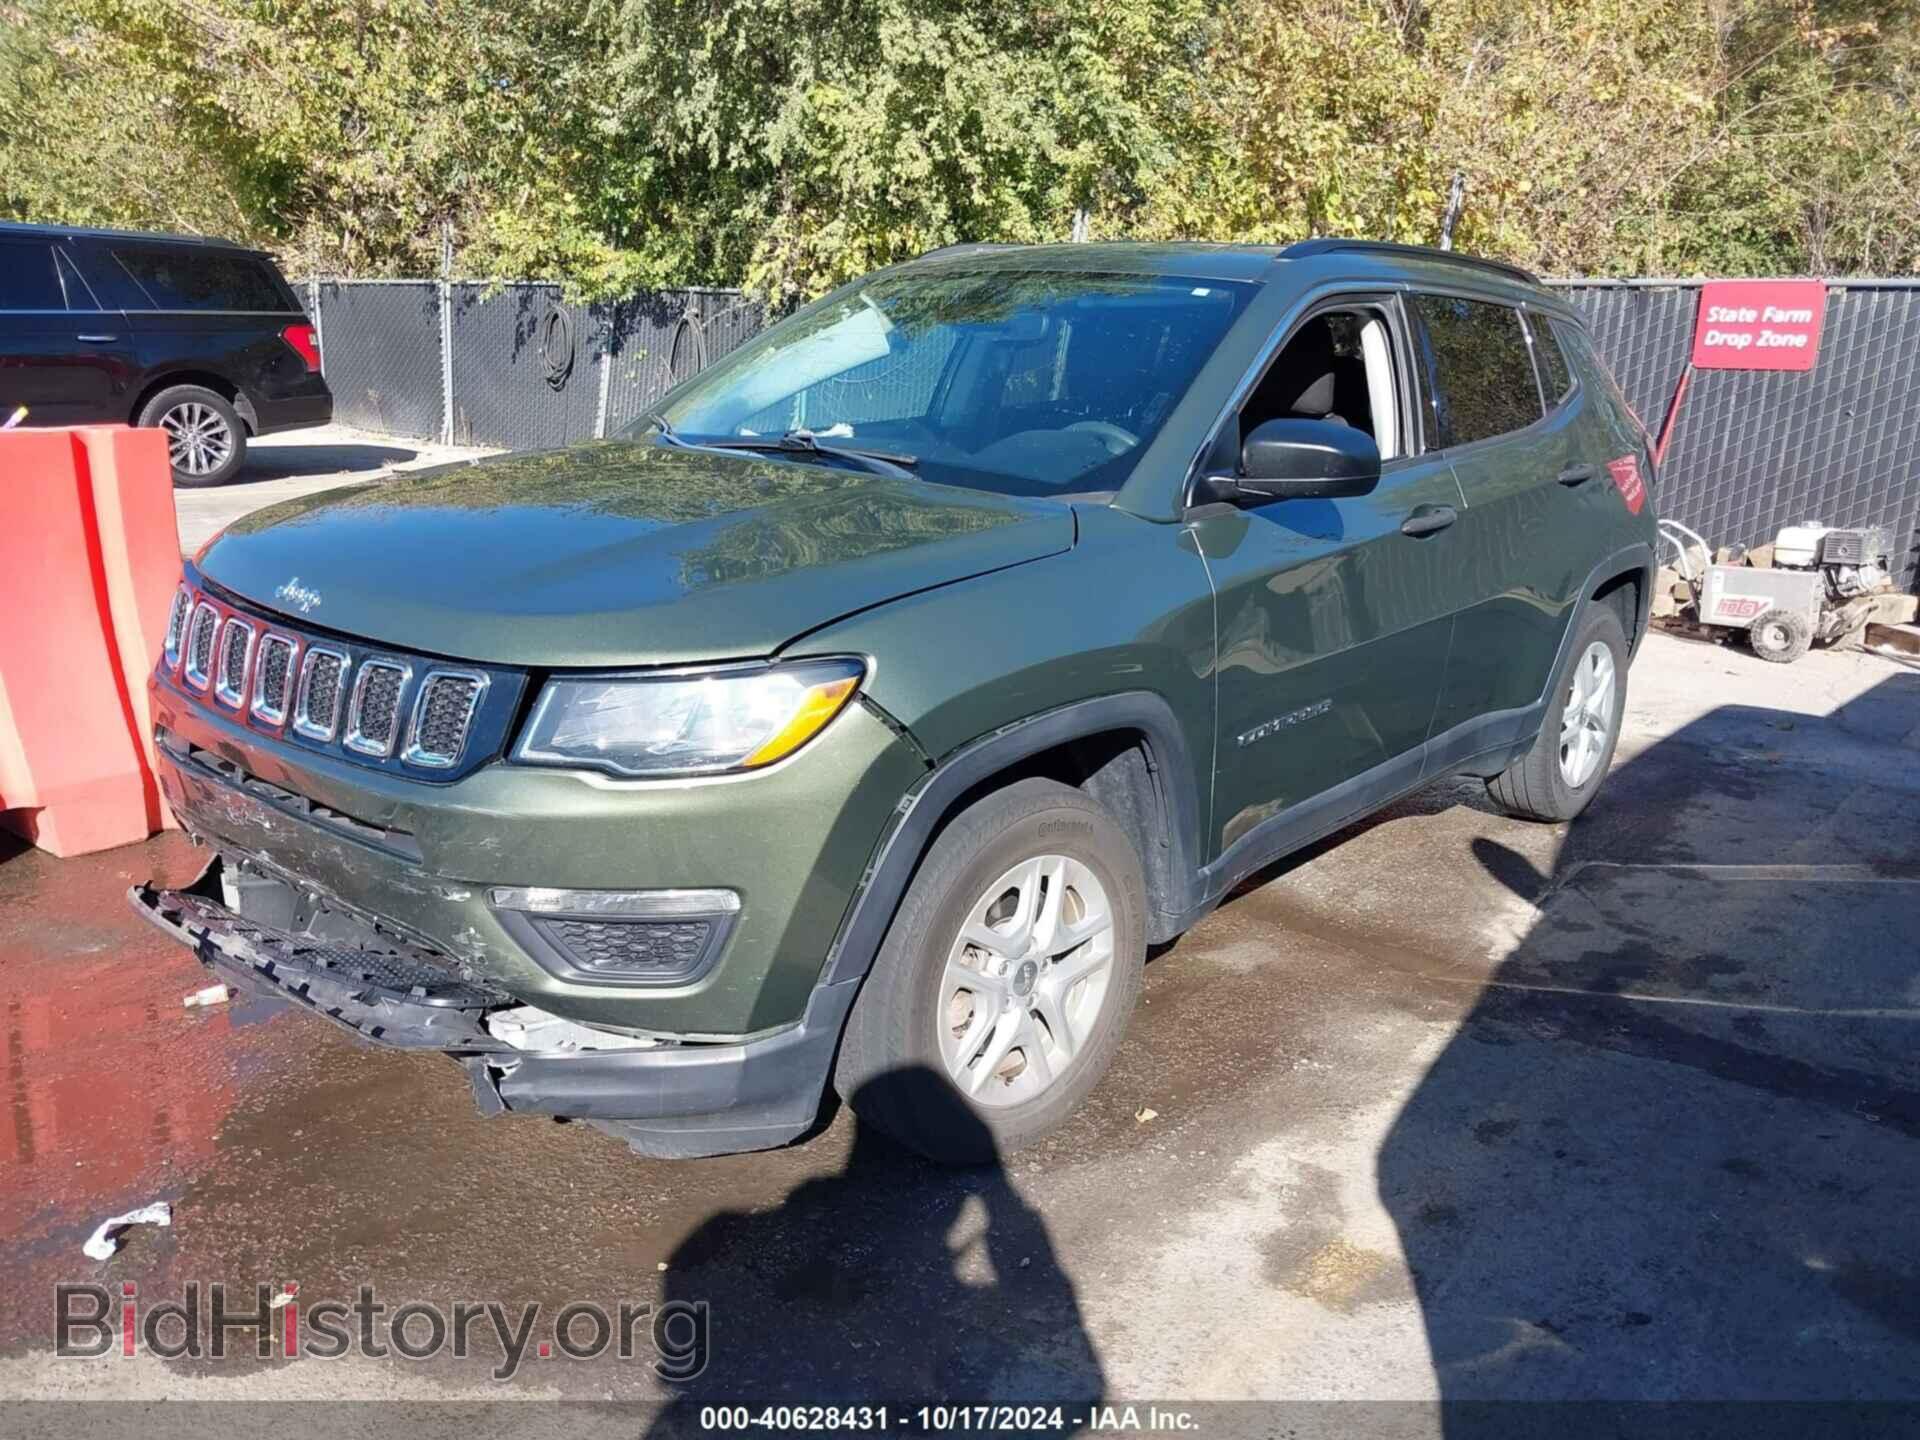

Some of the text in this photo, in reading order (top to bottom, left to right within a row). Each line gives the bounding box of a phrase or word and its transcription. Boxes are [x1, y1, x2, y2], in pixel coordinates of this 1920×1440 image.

[1706, 306, 1813, 323] State Farm
[1704, 330, 1808, 350] Drop Zone
